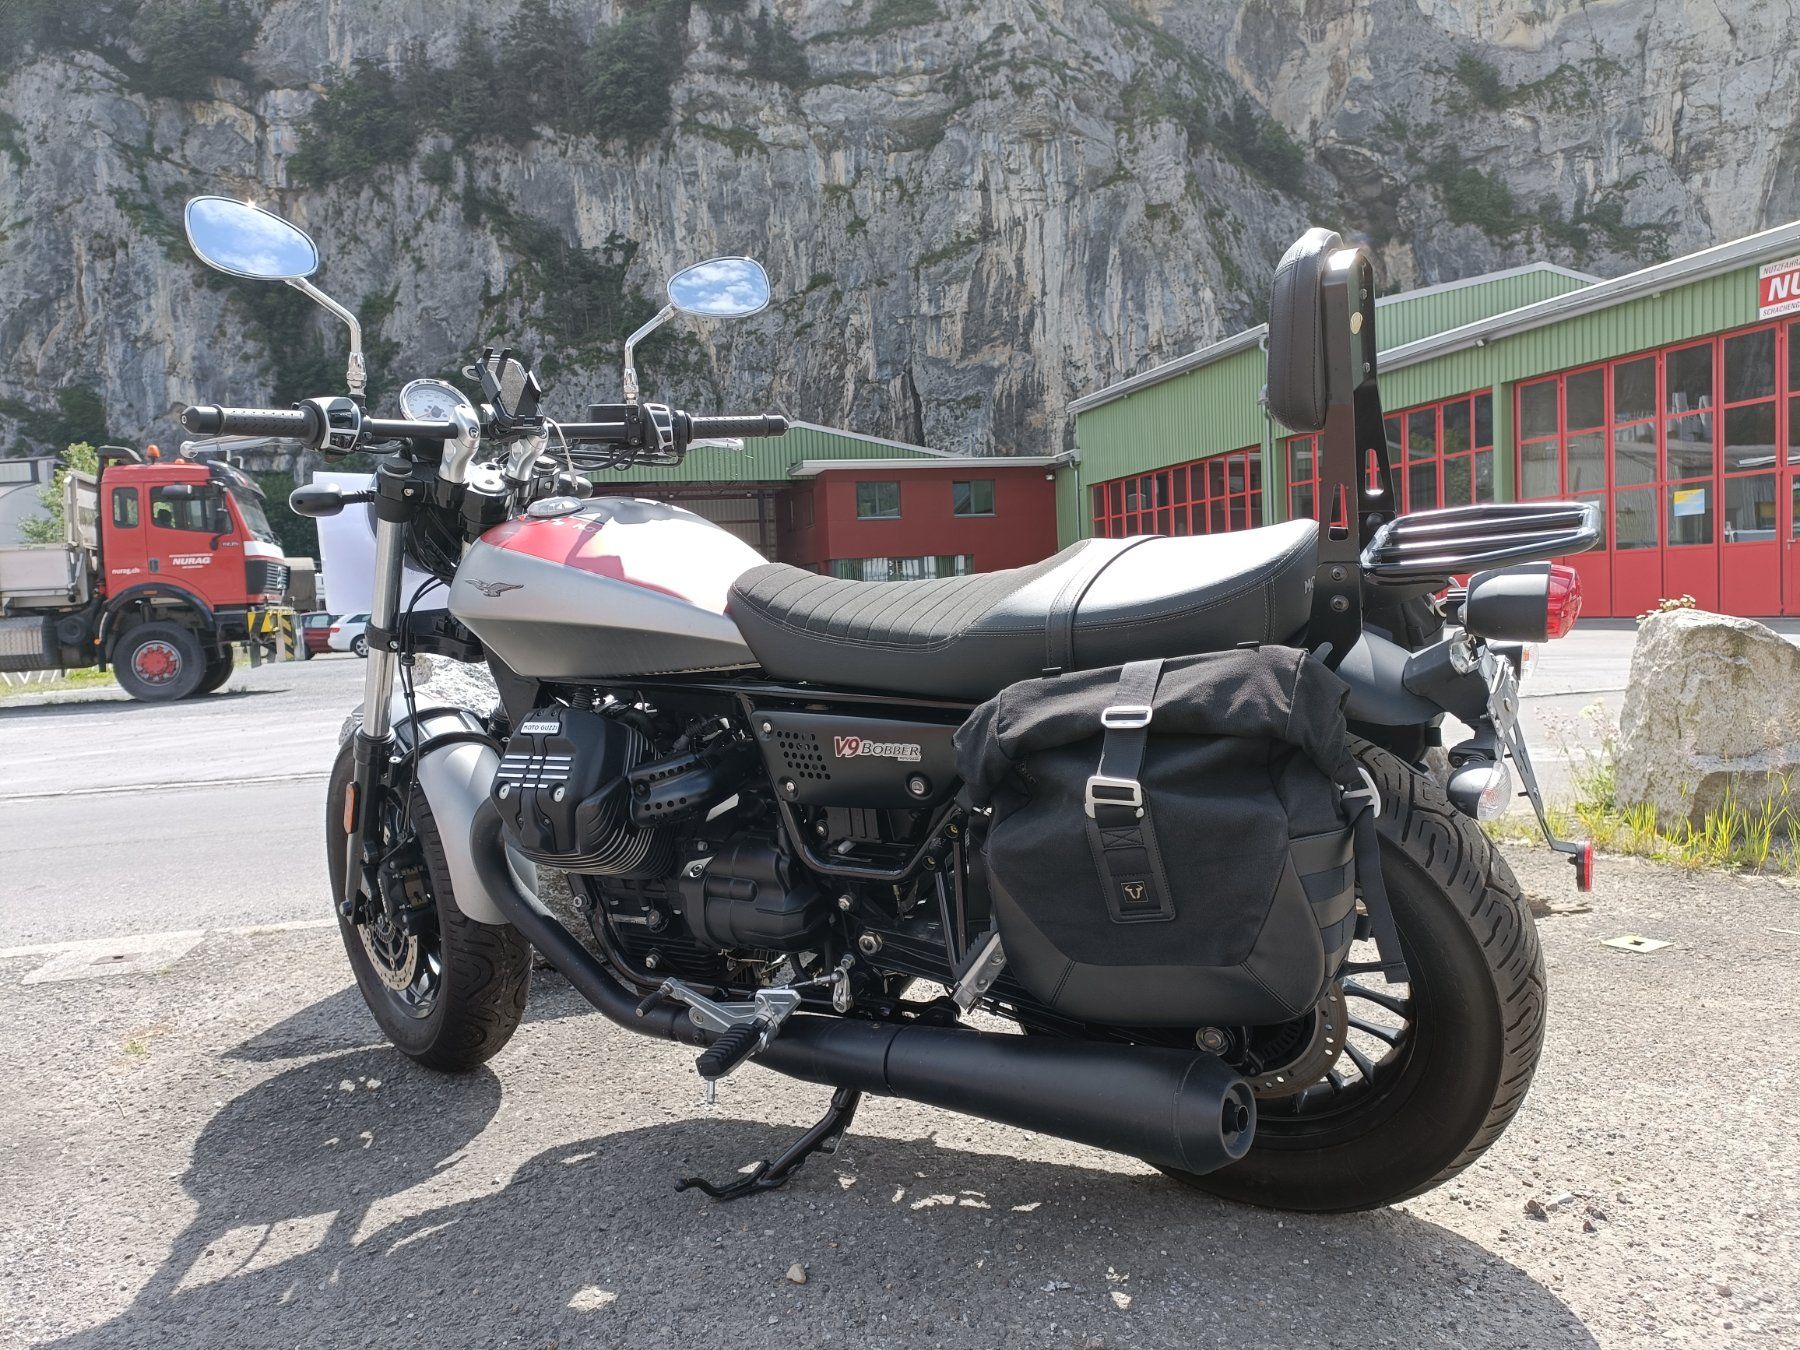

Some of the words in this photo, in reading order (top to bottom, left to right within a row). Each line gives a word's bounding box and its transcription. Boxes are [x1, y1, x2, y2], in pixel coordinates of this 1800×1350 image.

[172, 556, 211, 566] NURAG
[834, 736, 860, 758] V9
[860, 740, 921, 757] BOBBER
